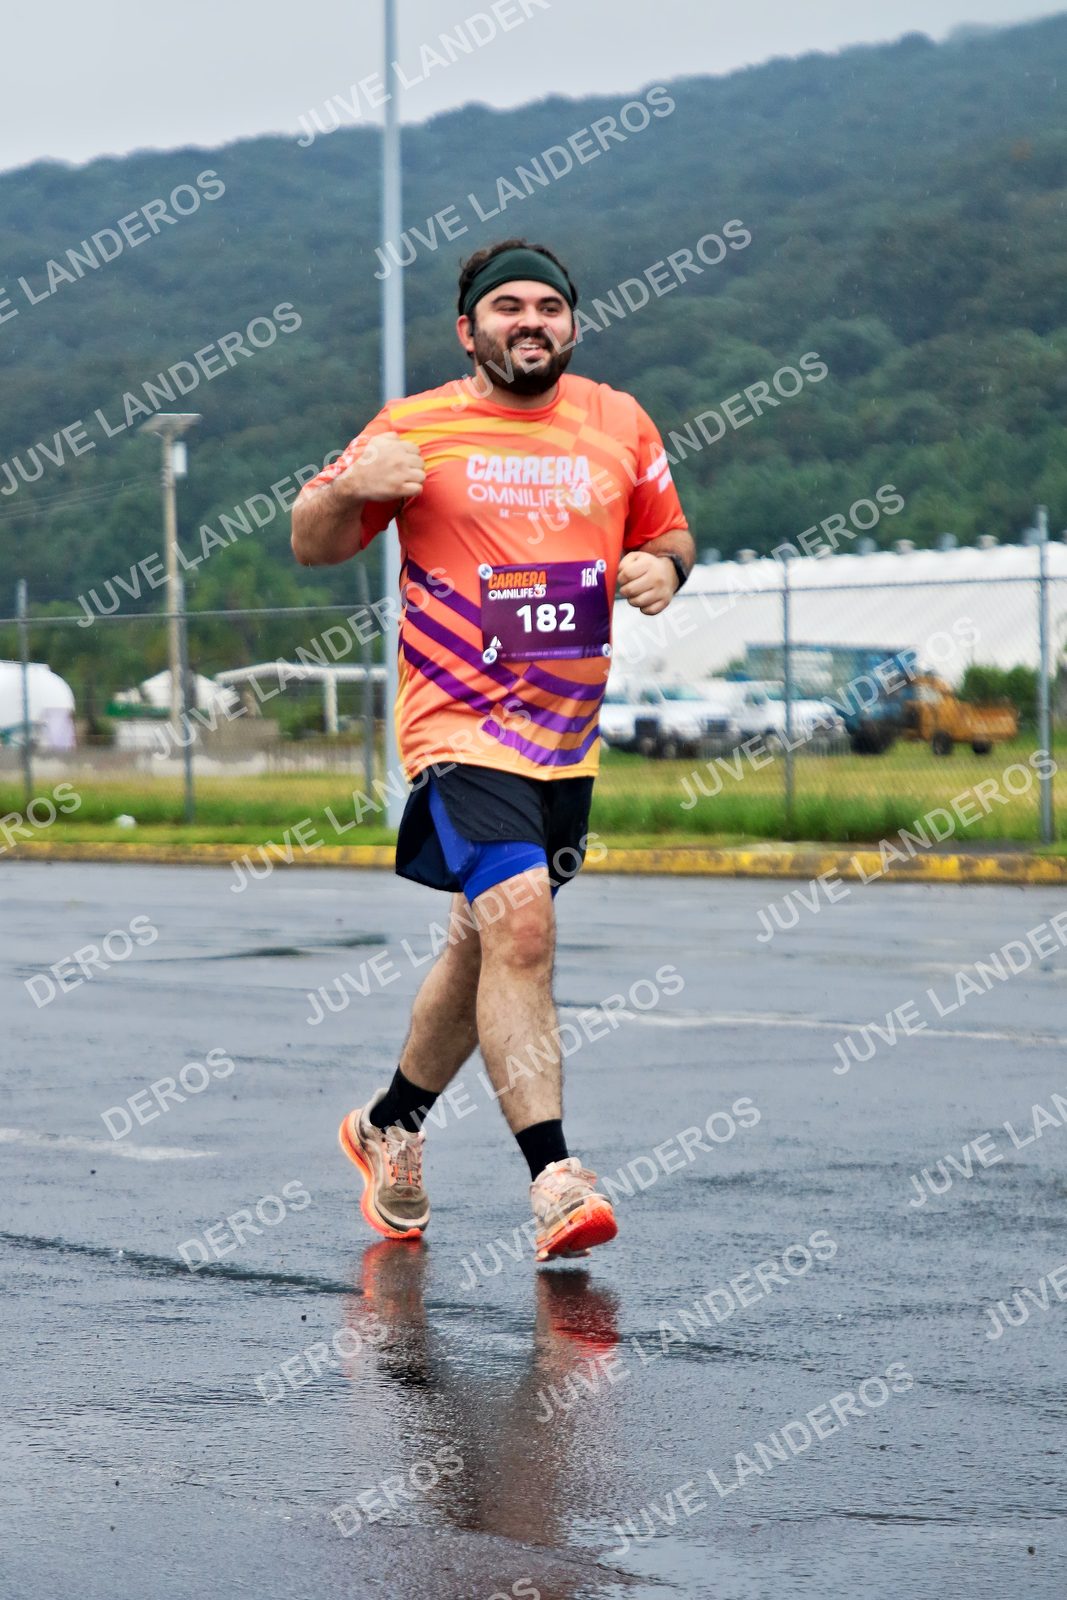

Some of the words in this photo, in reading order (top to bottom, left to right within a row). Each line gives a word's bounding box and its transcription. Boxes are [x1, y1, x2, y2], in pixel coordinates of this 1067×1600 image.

[466, 454, 591, 485] CARRERA
[488, 571, 547, 589] CARRERA
[516, 602, 576, 633] 182
